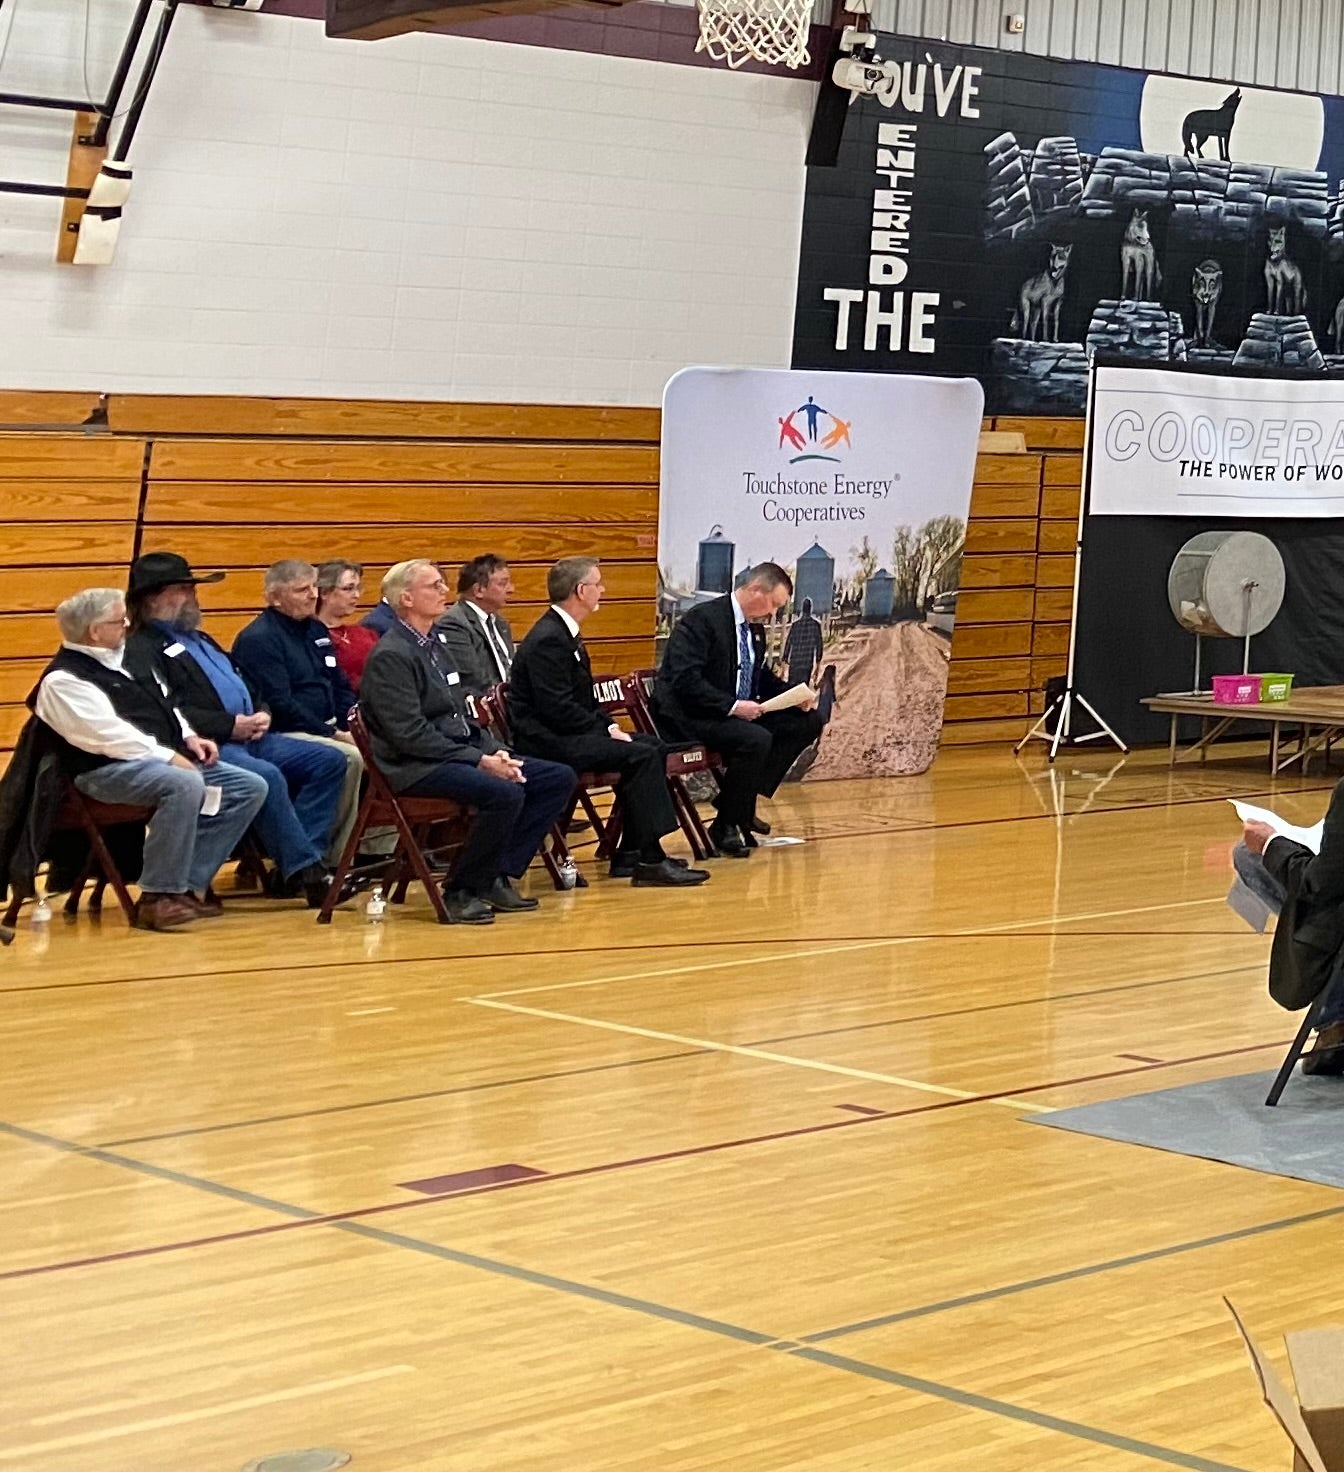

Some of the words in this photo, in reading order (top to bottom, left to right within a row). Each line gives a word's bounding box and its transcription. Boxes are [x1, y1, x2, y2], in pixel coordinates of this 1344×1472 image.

[849, 52, 982, 118] OU'VE
[869, 123, 917, 285] ENTERED
[824, 289, 939, 353] THE
[743, 472, 827, 496] Touchstone
[1179, 460, 1213, 478] THE
[1219, 465, 1275, 481] POWER
[1284, 466, 1306, 481] OF
[763, 500, 865, 527] Cooperatives
